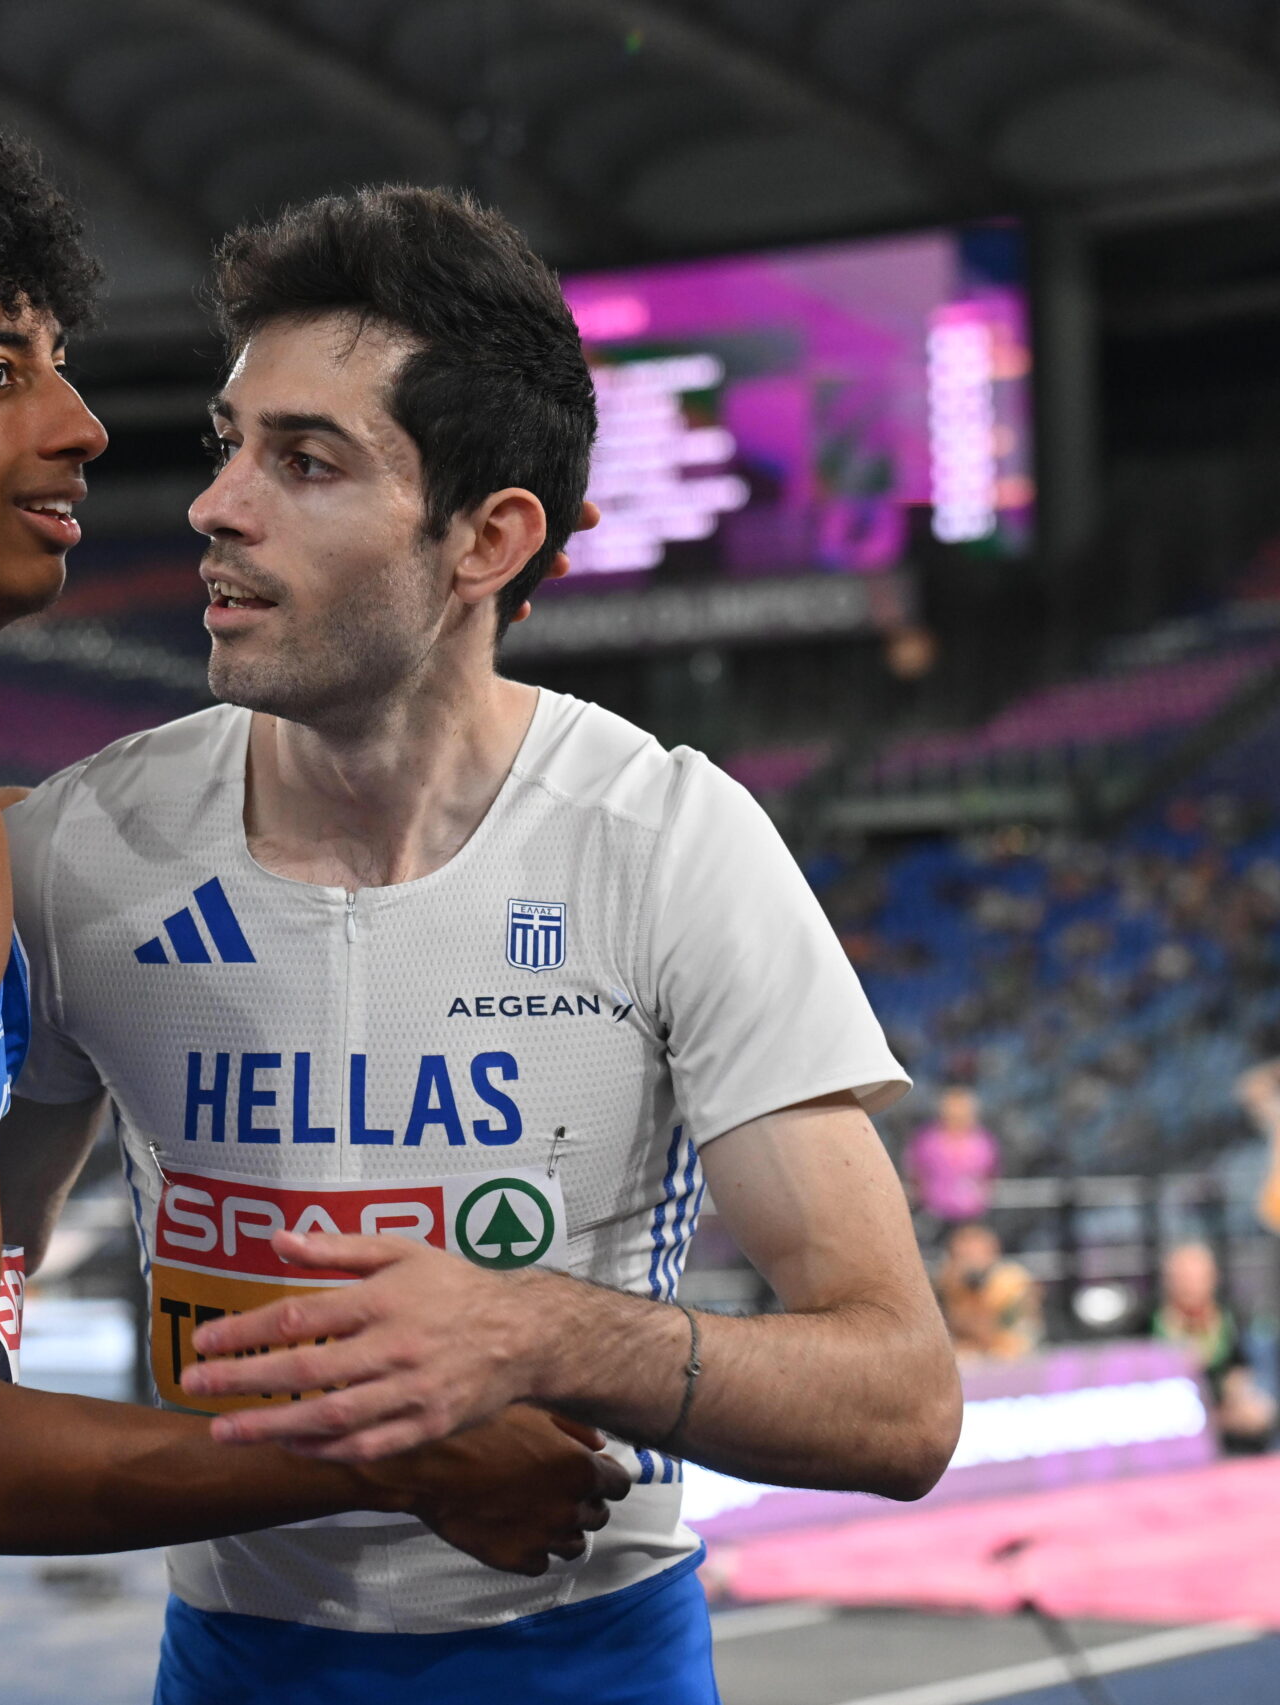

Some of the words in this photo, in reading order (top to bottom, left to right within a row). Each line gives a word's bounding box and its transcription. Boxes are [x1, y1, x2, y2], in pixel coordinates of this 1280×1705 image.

[520, 906, 553, 916] ΕΛΛΑΣ
[447, 995, 601, 1018] AEGEAN
[184, 1051, 523, 1146] HELLAS
